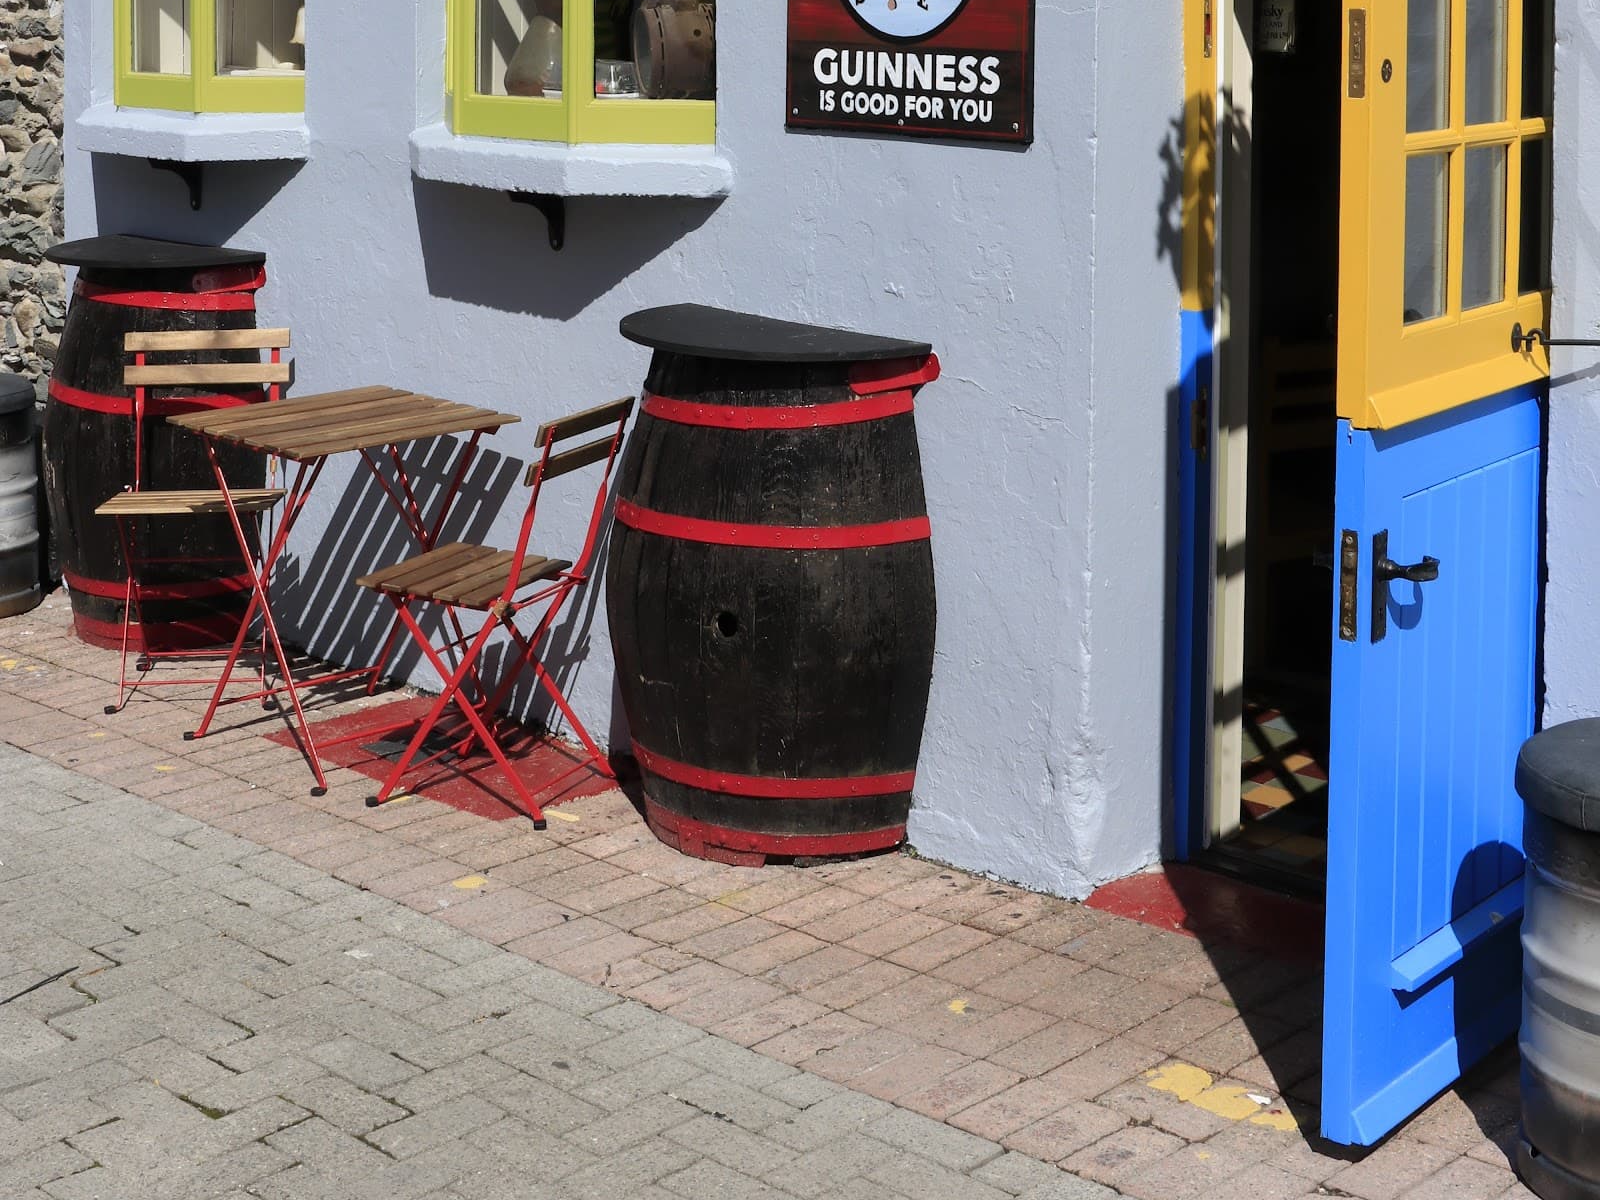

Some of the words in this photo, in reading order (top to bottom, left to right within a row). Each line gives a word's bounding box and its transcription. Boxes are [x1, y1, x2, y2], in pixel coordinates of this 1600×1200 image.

[813, 48, 1001, 95] GUINNESS
[819, 89, 836, 112] IS
[840, 91, 899, 116] GOOD
[904, 95, 944, 119] FOR
[949, 98, 993, 123] YOU
